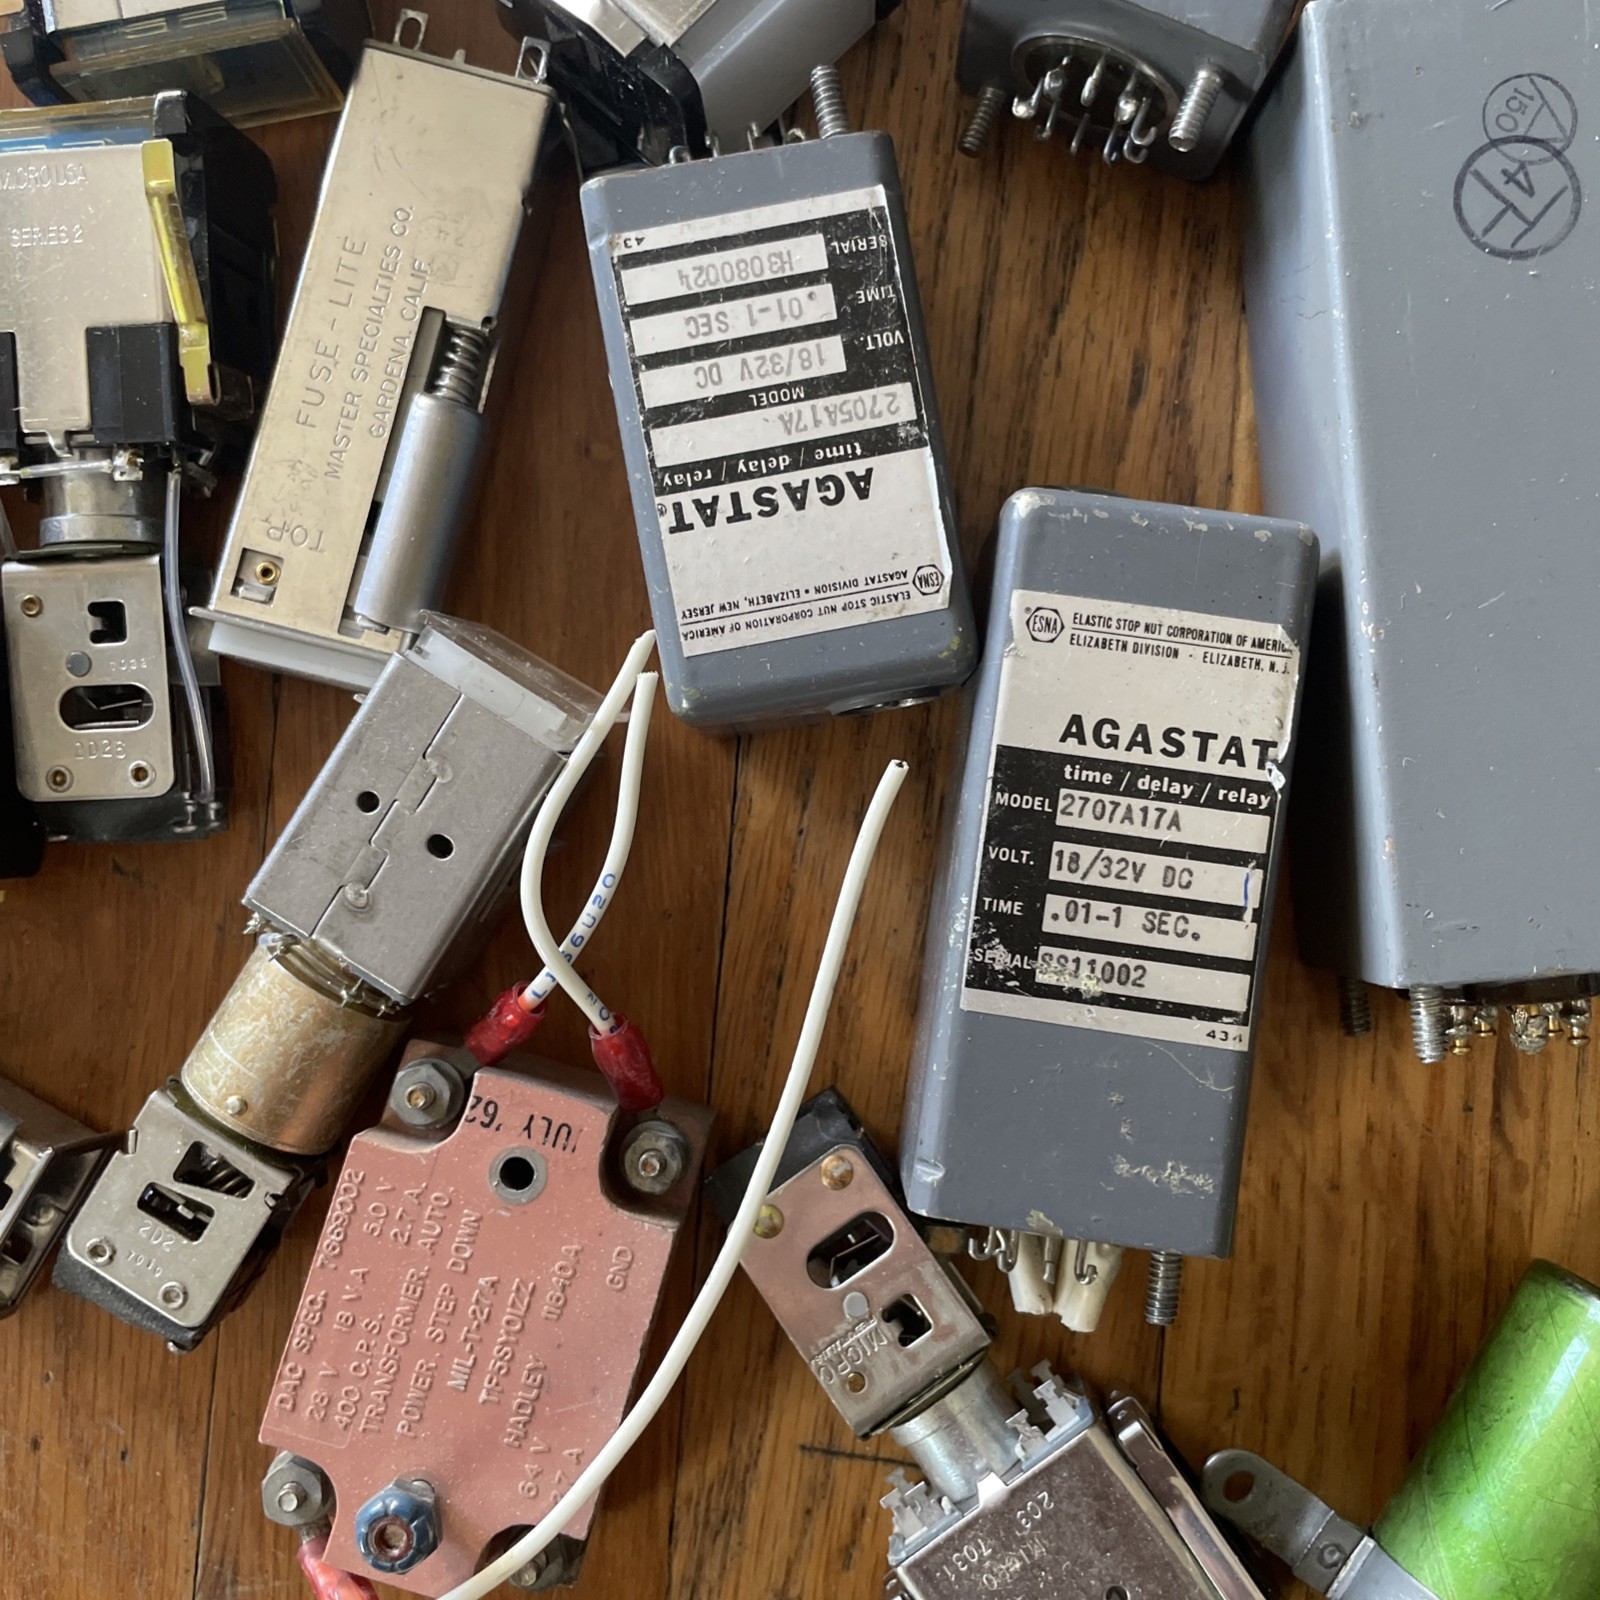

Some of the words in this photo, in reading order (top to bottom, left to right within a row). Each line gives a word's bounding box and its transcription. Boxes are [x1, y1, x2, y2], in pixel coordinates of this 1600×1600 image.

[1495, 87, 1535, 133] 150
[58, 164, 86, 186] USA
[11, 225, 69, 247] SERIES
[73, 224, 83, 244] 2
[831, 234, 888, 254] SERIAL
[856, 284, 896, 304] TIME
[747, 291, 817, 327] .01-1
[296, 339, 340, 428] FUSE
[329, 236, 367, 308] LITE
[684, 311, 730, 339] SEC
[324, 391, 363, 480] MASTER
[352, 245, 402, 382] SPECIALTIES
[391, 206, 415, 237] CO.
[860, 330, 905, 351] VOLT.
[740, 343, 826, 381] 18/32V
[694, 361, 723, 389] DC
[749, 386, 805, 407] MODEL
[778, 392, 900, 436] 2705A17A
[815, 442, 862, 460] time
[737, 454, 790, 474] delay
[662, 468, 712, 488] relay
[669, 467, 874, 534] AGASTAT
[267, 520, 327, 553] TOP
[814, 579, 858, 594] DIVISION
[864, 570, 908, 586] AGASTAT
[917, 571, 940, 589] ESNA
[719, 600, 740, 612] NEW
[744, 589, 801, 607] ELIZABETH,
[842, 600, 867, 612] STOP
[871, 590, 911, 606] ELASTIC
[681, 604, 714, 619] JERSEY
[745, 609, 813, 629] CORPORATION
[817, 604, 837, 616] NUT
[681, 625, 725, 641] AMERICA
[729, 621, 741, 633] OF
[1032, 614, 1058, 634] ESNA
[1073, 612, 1113, 629] ELASTIC
[1116, 618, 1141, 632] STOP
[1144, 623, 1163, 635] NUT
[1167, 625, 1232, 645] CORPORATION
[1236, 635, 1248, 647] OF
[1070, 633, 1128, 652] ELIZABETH
[1132, 642, 1179, 659] DIVISION
[1203, 652, 1264, 672] ELIZABETH,
[1058, 714, 1278, 771] AGASTAT
[1063, 764, 1113, 785] time
[1137, 775, 1194, 799] delay
[1218, 788, 1271, 809] relay
[995, 792, 1053, 812] MODEL
[1060, 793, 1182, 832] 2707A17A
[988, 846, 1034, 865] VOLT.
[1055, 849, 1147, 883] 18/32V
[1162, 865, 1194, 890] DC
[982, 897, 1024, 916] TIME
[1051, 899, 1122, 928] .01-1
[1142, 911, 1200, 941] SEC.
[973, 947, 1031, 970] SERIAL
[425, 1283, 457, 1344] STEP
[447, 1208, 483, 1274] DOWN
[605, 1245, 635, 1292] GND
[305, 1391, 330, 1421] 28
[318, 1361, 339, 1377] V
[363, 1202, 388, 1237] 5.0
[334, 1385, 362, 1430] 400
[391, 1206, 413, 1246] 2.7
[447, 1275, 500, 1392] MIL-T-27A
[274, 1362, 305, 1412] DAC
[503, 1353, 547, 1449] HADLEY
[530, 1436, 551, 1455] V
[562, 1446, 584, 1465] A
